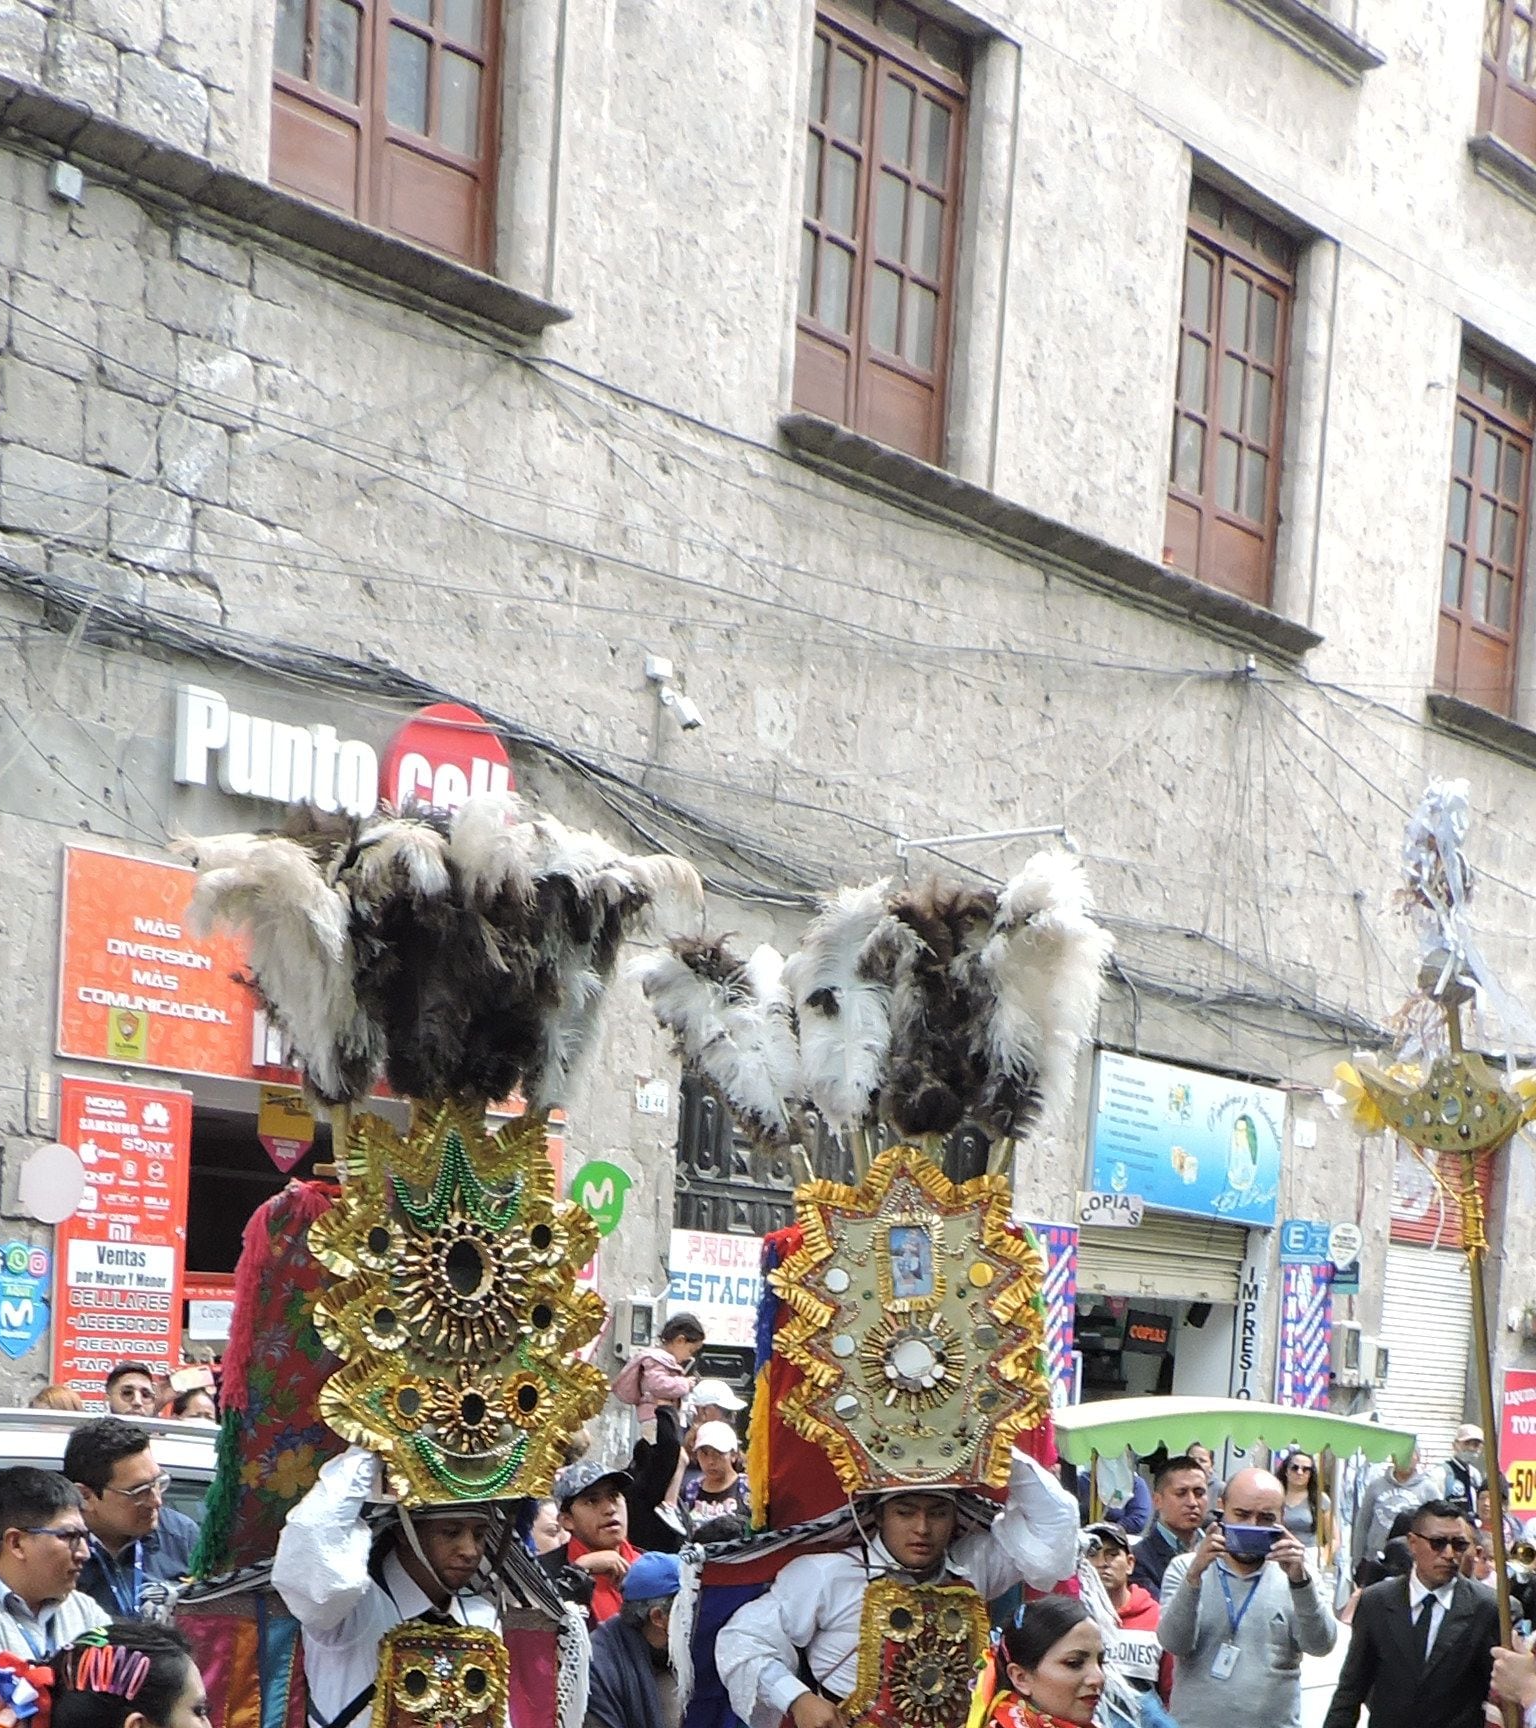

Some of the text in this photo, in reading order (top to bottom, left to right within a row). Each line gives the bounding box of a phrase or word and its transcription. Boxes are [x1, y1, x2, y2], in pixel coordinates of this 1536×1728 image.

[175, 684, 378, 819] Punto
[134, 916, 182, 940] MÁS
[107, 938, 212, 971] DIVERSIÓN
[132, 969, 180, 991] MÁS
[79, 1118, 139, 1136] SAMSUNG
[121, 1137, 175, 1155] SONY
[1080, 1194, 1140, 1226] COPIAS
[97, 1245, 146, 1267] Ventas
[75, 1271, 93, 1283] por
[96, 1270, 126, 1286] Mayor
[137, 1273, 167, 1288] Menor
[70, 1289, 171, 1312] CELULARES
